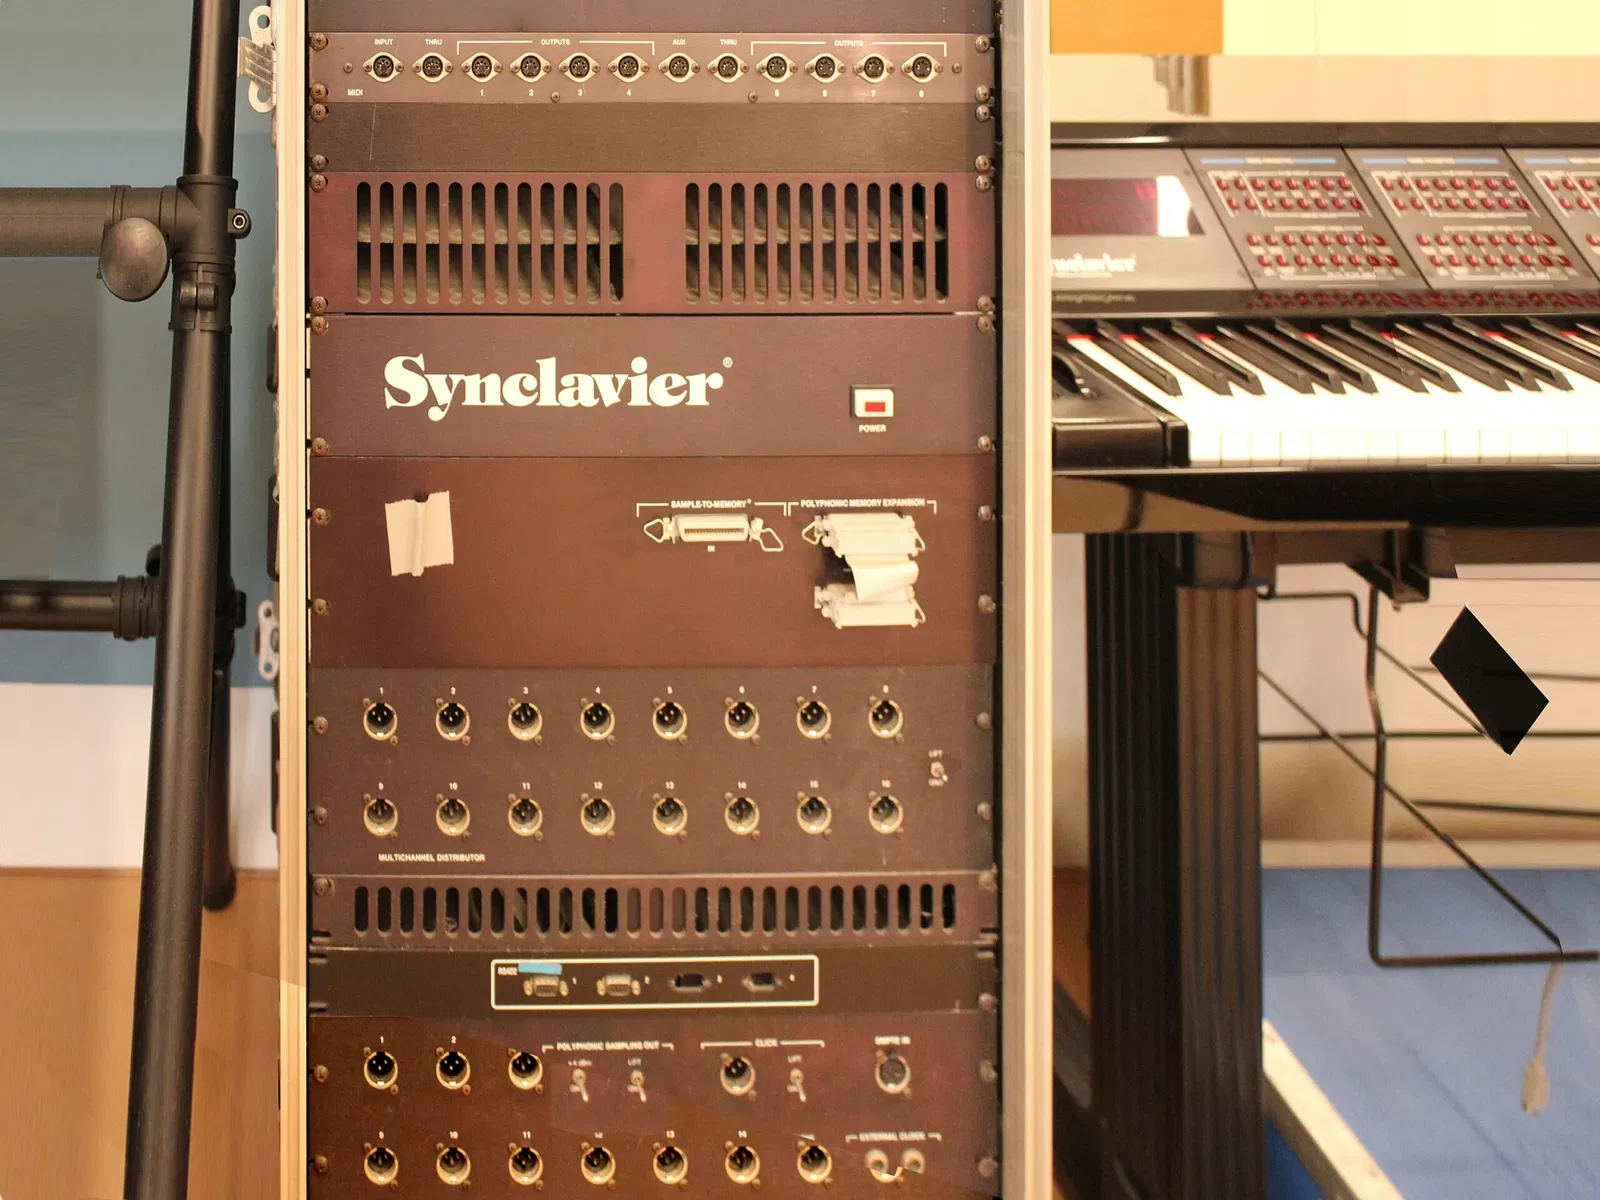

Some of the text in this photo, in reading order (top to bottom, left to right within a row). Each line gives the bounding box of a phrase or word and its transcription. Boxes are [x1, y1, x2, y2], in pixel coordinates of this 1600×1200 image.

[374, 38, 394, 46] INPUT
[424, 38, 443, 46] THRU
[540, 38, 571, 46] OUTPUTS
[672, 38, 686, 46] AUX
[719, 38, 738, 46] THRU
[834, 39, 865, 47] OUTPUTS
[347, 88, 363, 97] MIDI
[528, 88, 534, 97] 2
[577, 88, 583, 97] 3
[626, 88, 632, 97] 4
[774, 88, 780, 97] 5
[822, 89, 828, 98] 6
[870, 89, 877, 98] 7
[858, 424, 887, 433] POWER
[800, 497, 926, 508] POLYPHONIC MEMORY EXPANSION
[450, 686, 456, 695] 2
[523, 686, 529, 695] 3
[594, 686, 601, 695] 4
[667, 685, 673, 695] 5
[811, 685, 818, 694] 7
[378, 782, 384, 791] 9
[448, 782, 458, 791] 10
[522, 782, 531, 790] 11
[593, 781, 603, 790] 12
[665, 781, 675, 790] 13
[737, 781, 747, 790] 14
[809, 779, 819, 789] 15
[881, 779, 891, 788] 16
[378, 853, 486, 862] MULTICHANNEL DISTRIBUTOR
[451, 1035, 457, 1044] 2
[556, 1041, 605, 1051] POLYPHONIC
[643, 1040, 660, 1050] OUT
[378, 1131, 385, 1140] 9
[449, 1131, 459, 1140] 10
[522, 1130, 531, 1139] 11
[666, 1130, 675, 1139] 13
